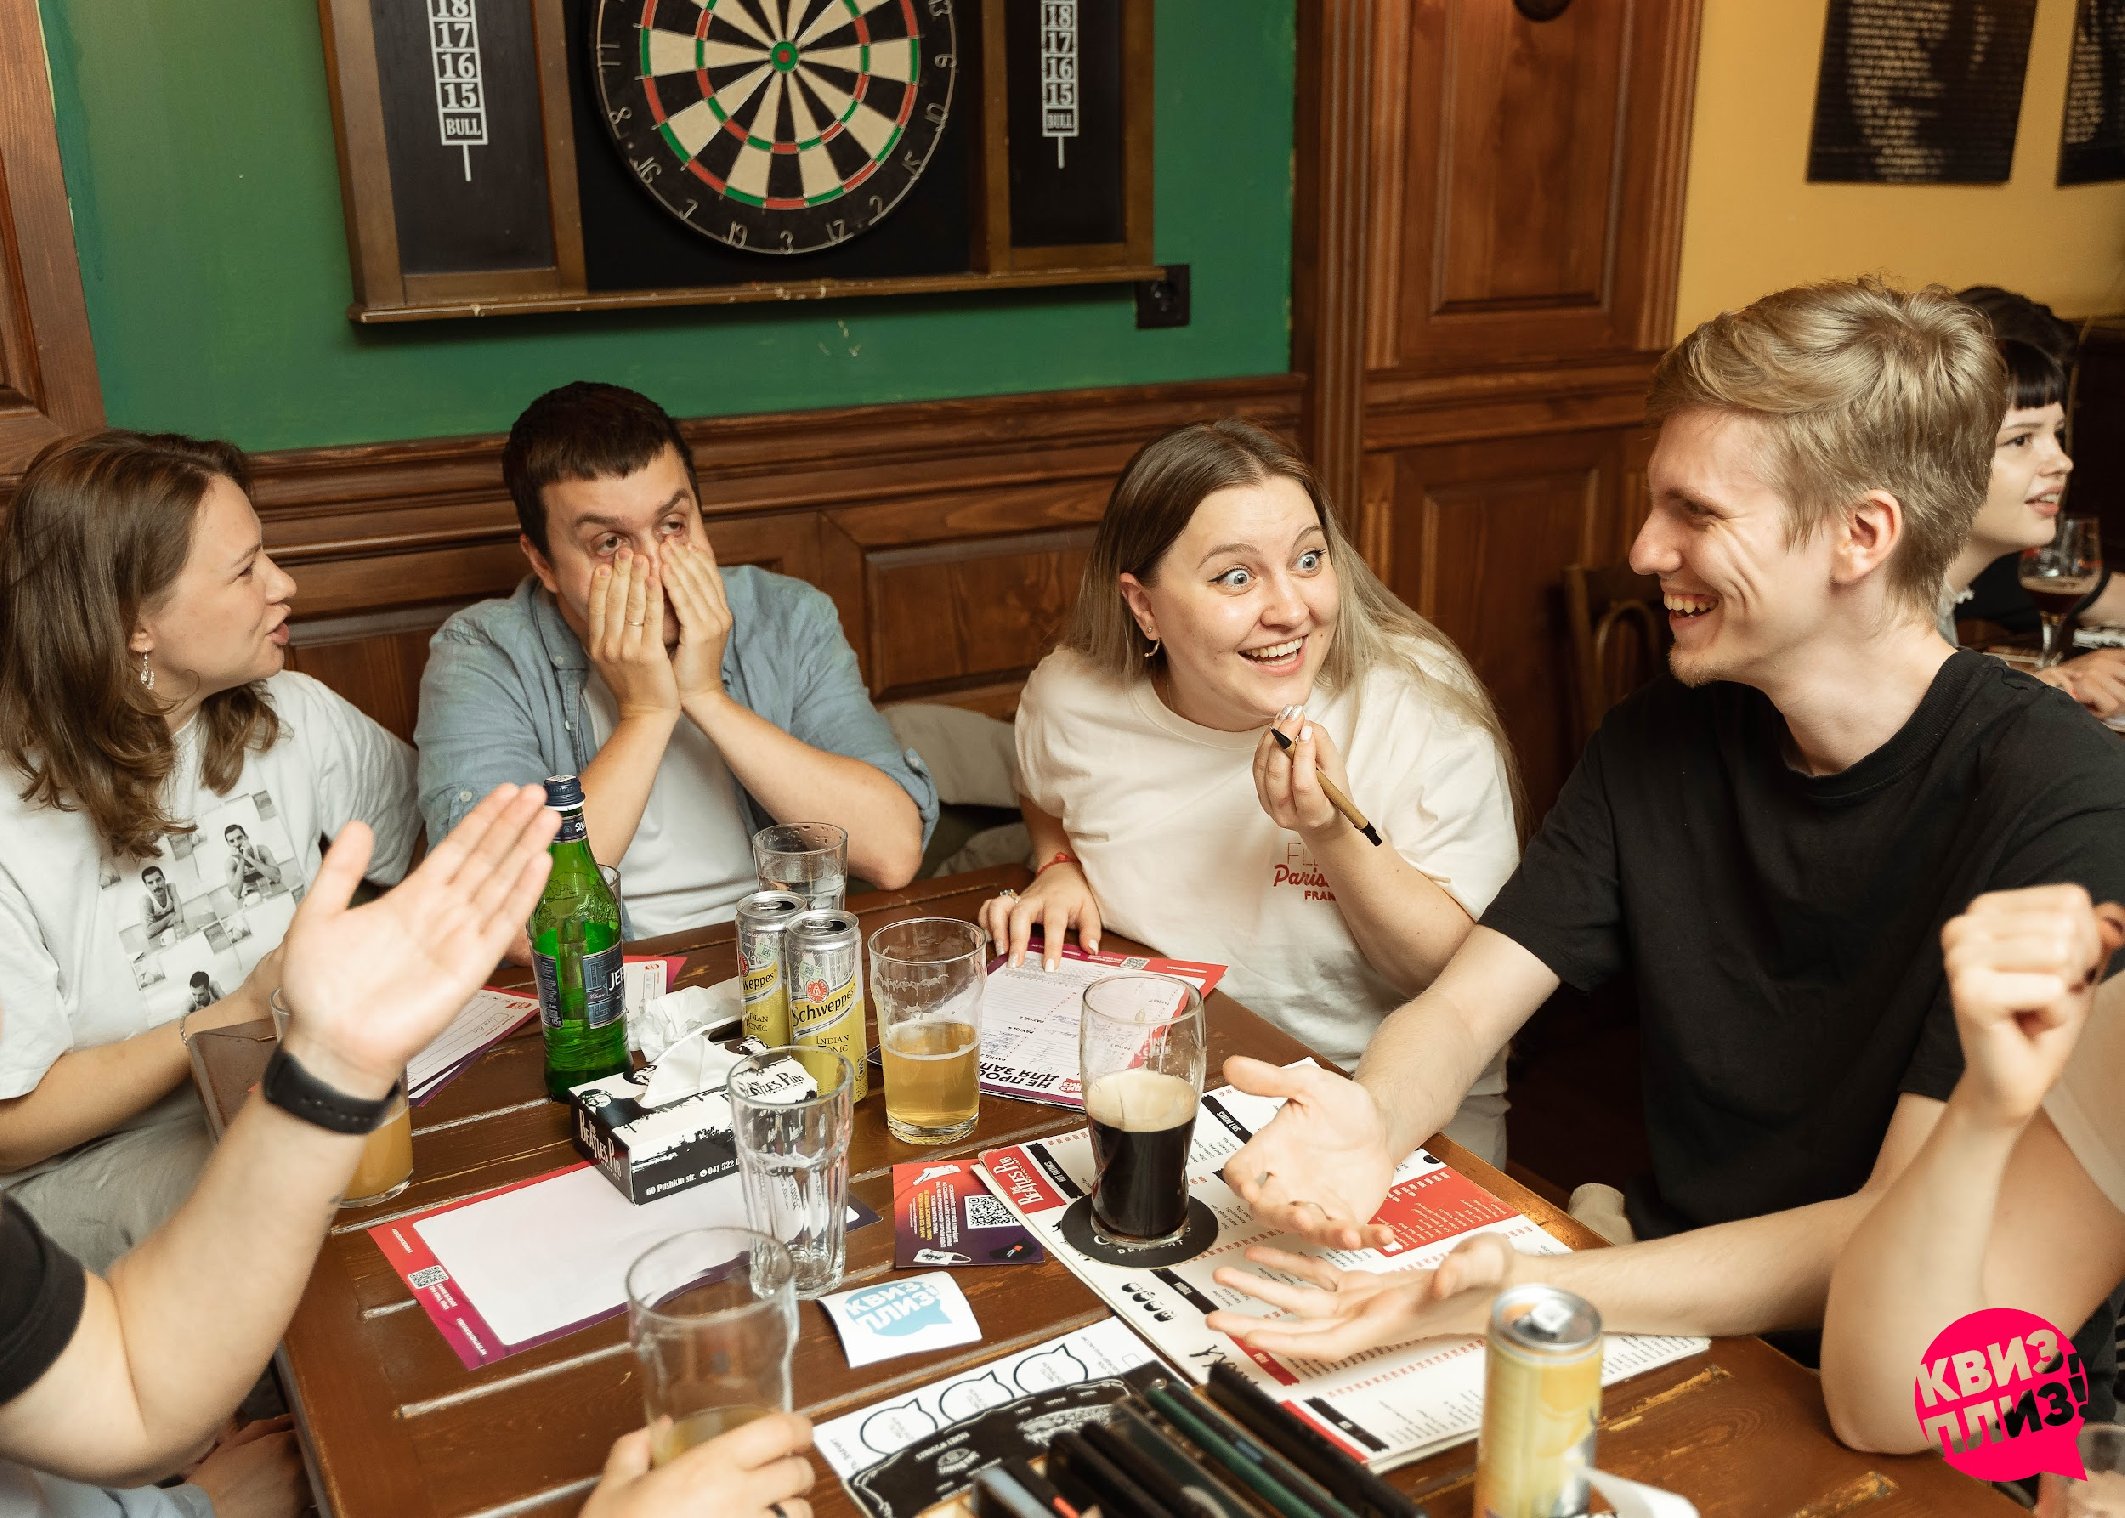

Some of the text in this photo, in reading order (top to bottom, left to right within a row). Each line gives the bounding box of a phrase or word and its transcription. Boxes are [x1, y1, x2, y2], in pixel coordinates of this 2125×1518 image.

[1048, 5, 1072, 28] 18
[437, 22, 470, 48] 17
[1048, 31, 1072, 54] 17
[441, 53, 475, 79] 16
[1048, 57, 1072, 80] 16
[444, 83, 477, 108] 15
[1048, 83, 1072, 106] 15
[609, 106, 632, 124] 8
[446, 118, 481, 136] BULL
[780, 231, 793, 254] 3
[1273, 863, 1330, 888] Paris
[792, 989, 854, 1027] Schweppes
[1026, 1077, 1053, 1089] НЕ
[657, 1175, 685, 1193] Pushkin
[685, 1173, 697, 1183] str.
